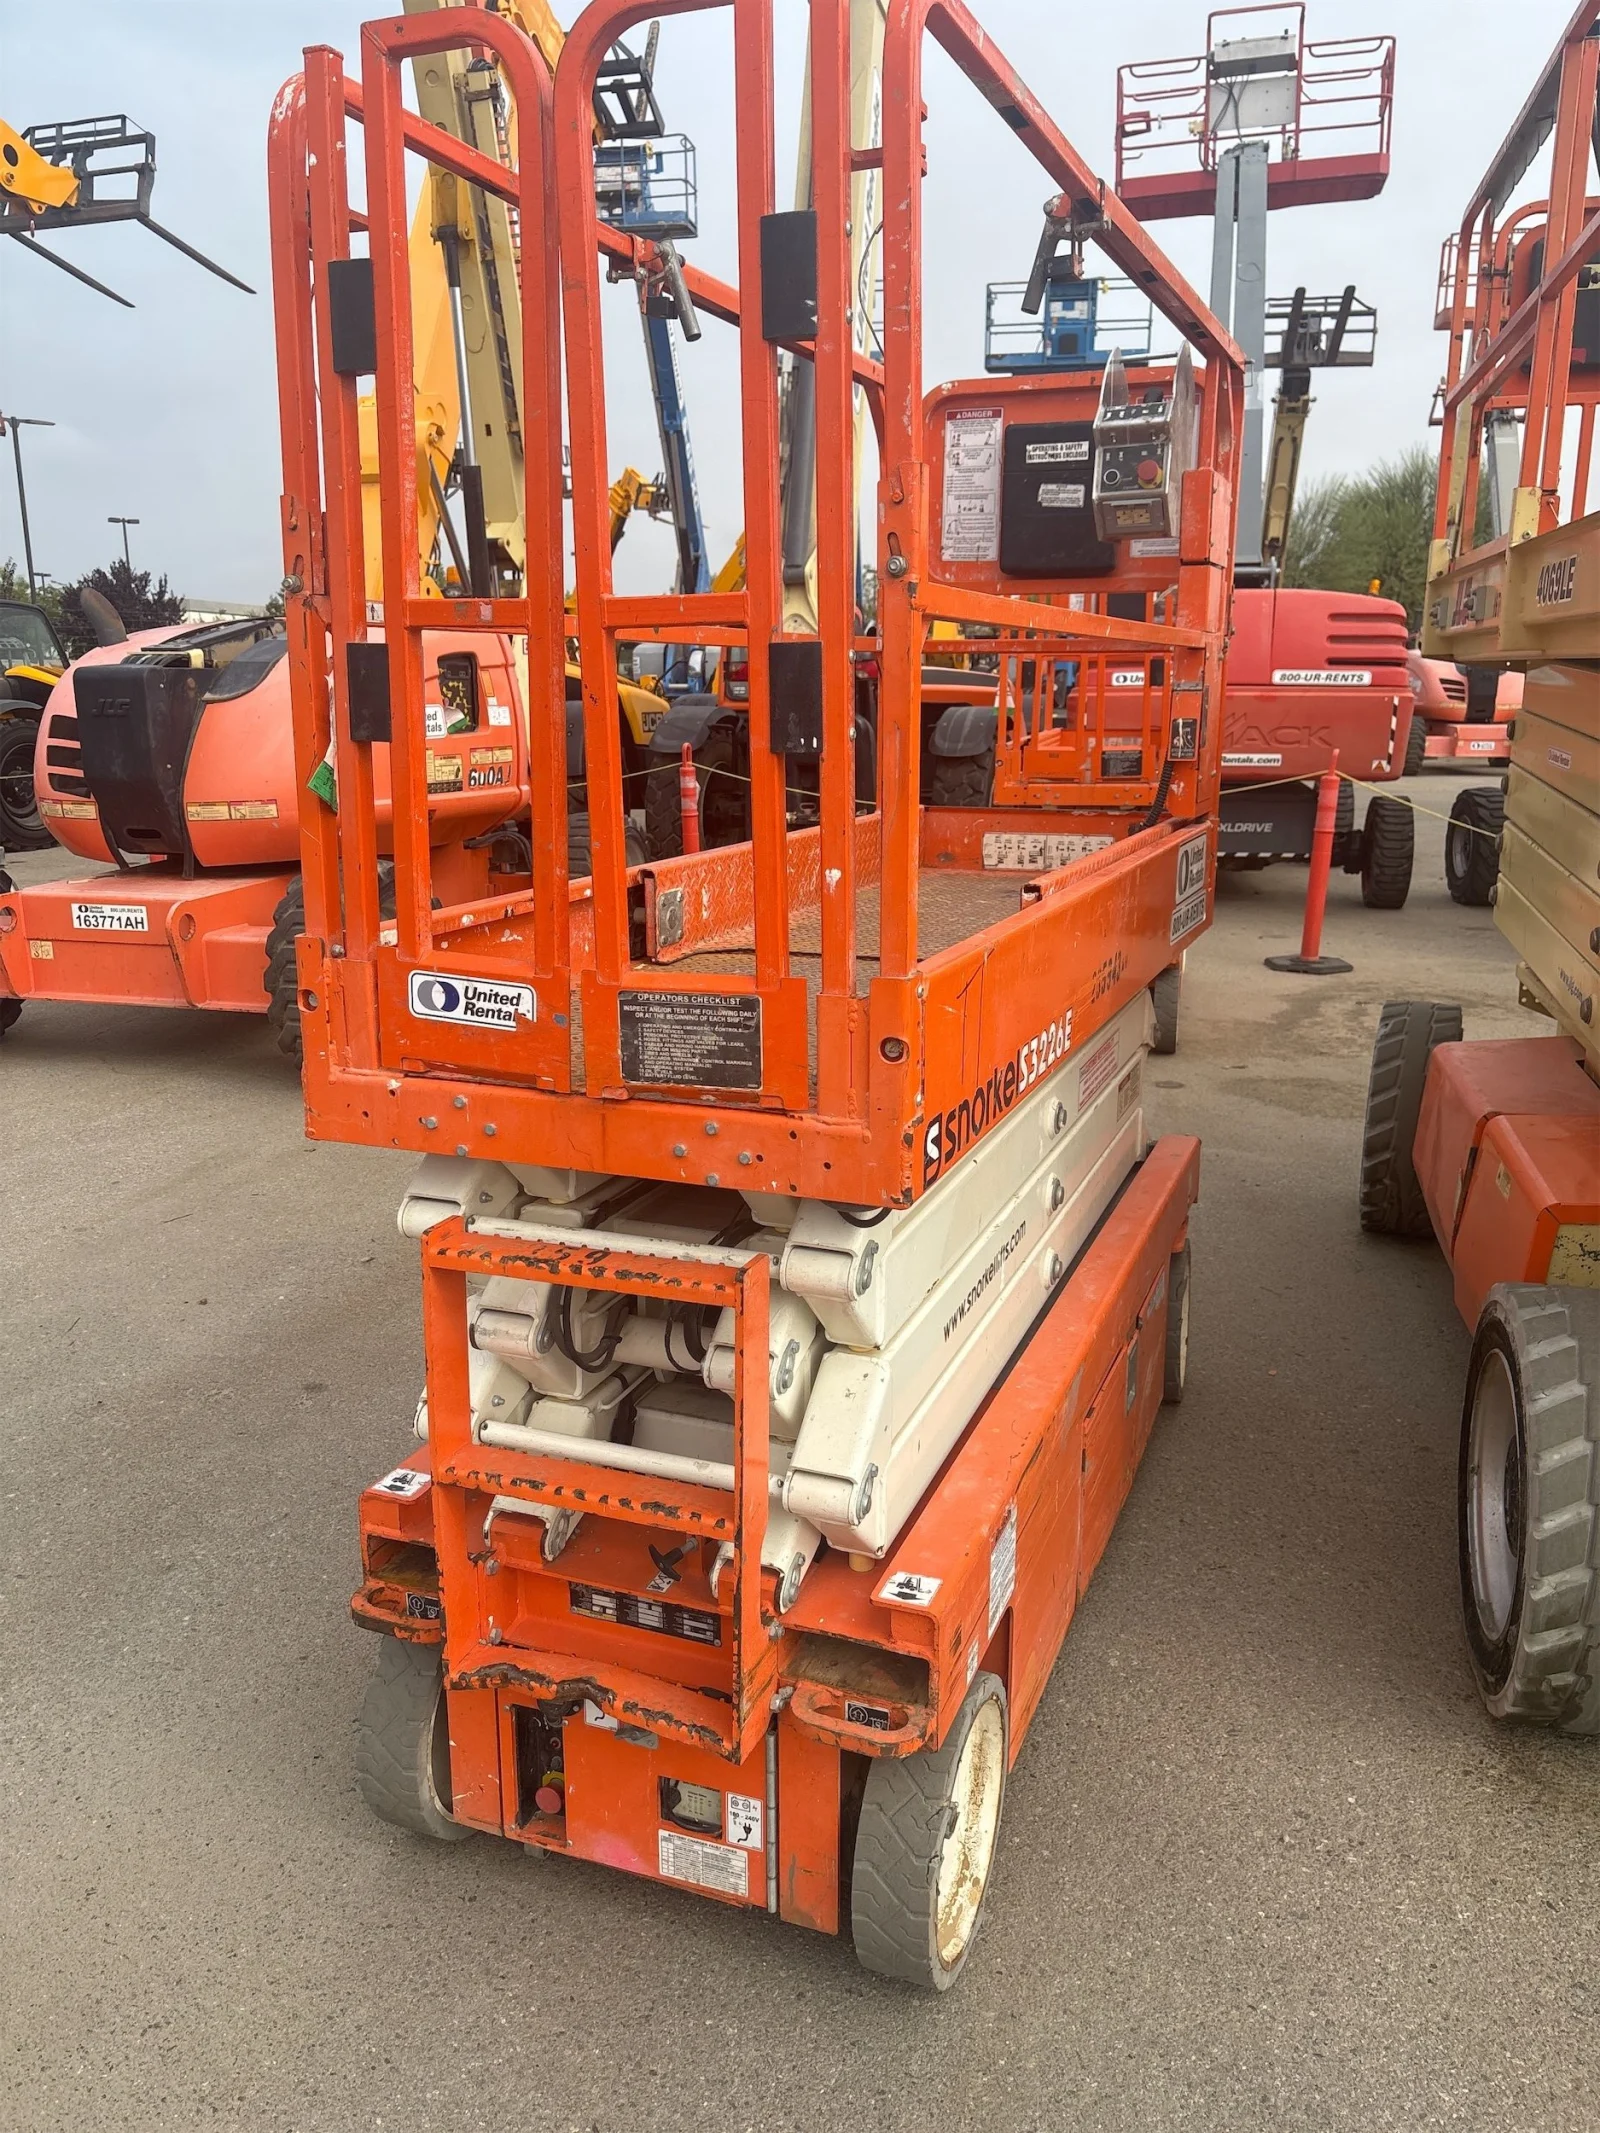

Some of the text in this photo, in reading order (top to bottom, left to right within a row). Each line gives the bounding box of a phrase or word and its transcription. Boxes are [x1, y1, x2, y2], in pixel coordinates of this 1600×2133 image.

[1032, 444, 1058, 452] OPERATING
[1065, 442, 1083, 450] SAFETY
[1063, 450, 1088, 459] ENCLOSED
[1537, 556, 1576, 604] 4069LE
[1280, 673, 1364, 683] 800-UR-RENTS
[76, 914, 144, 929] 163771AH
[464, 986, 521, 1006] United
[638, 994, 740, 1005] OPERATORS CHECKLIST
[464, 1001, 526, 1022] Renta
[944, 1049, 1020, 1165] snorkel
[1019, 1007, 1072, 1094] S3226E
[943, 1220, 1026, 1343] www.snorkellifts.com
